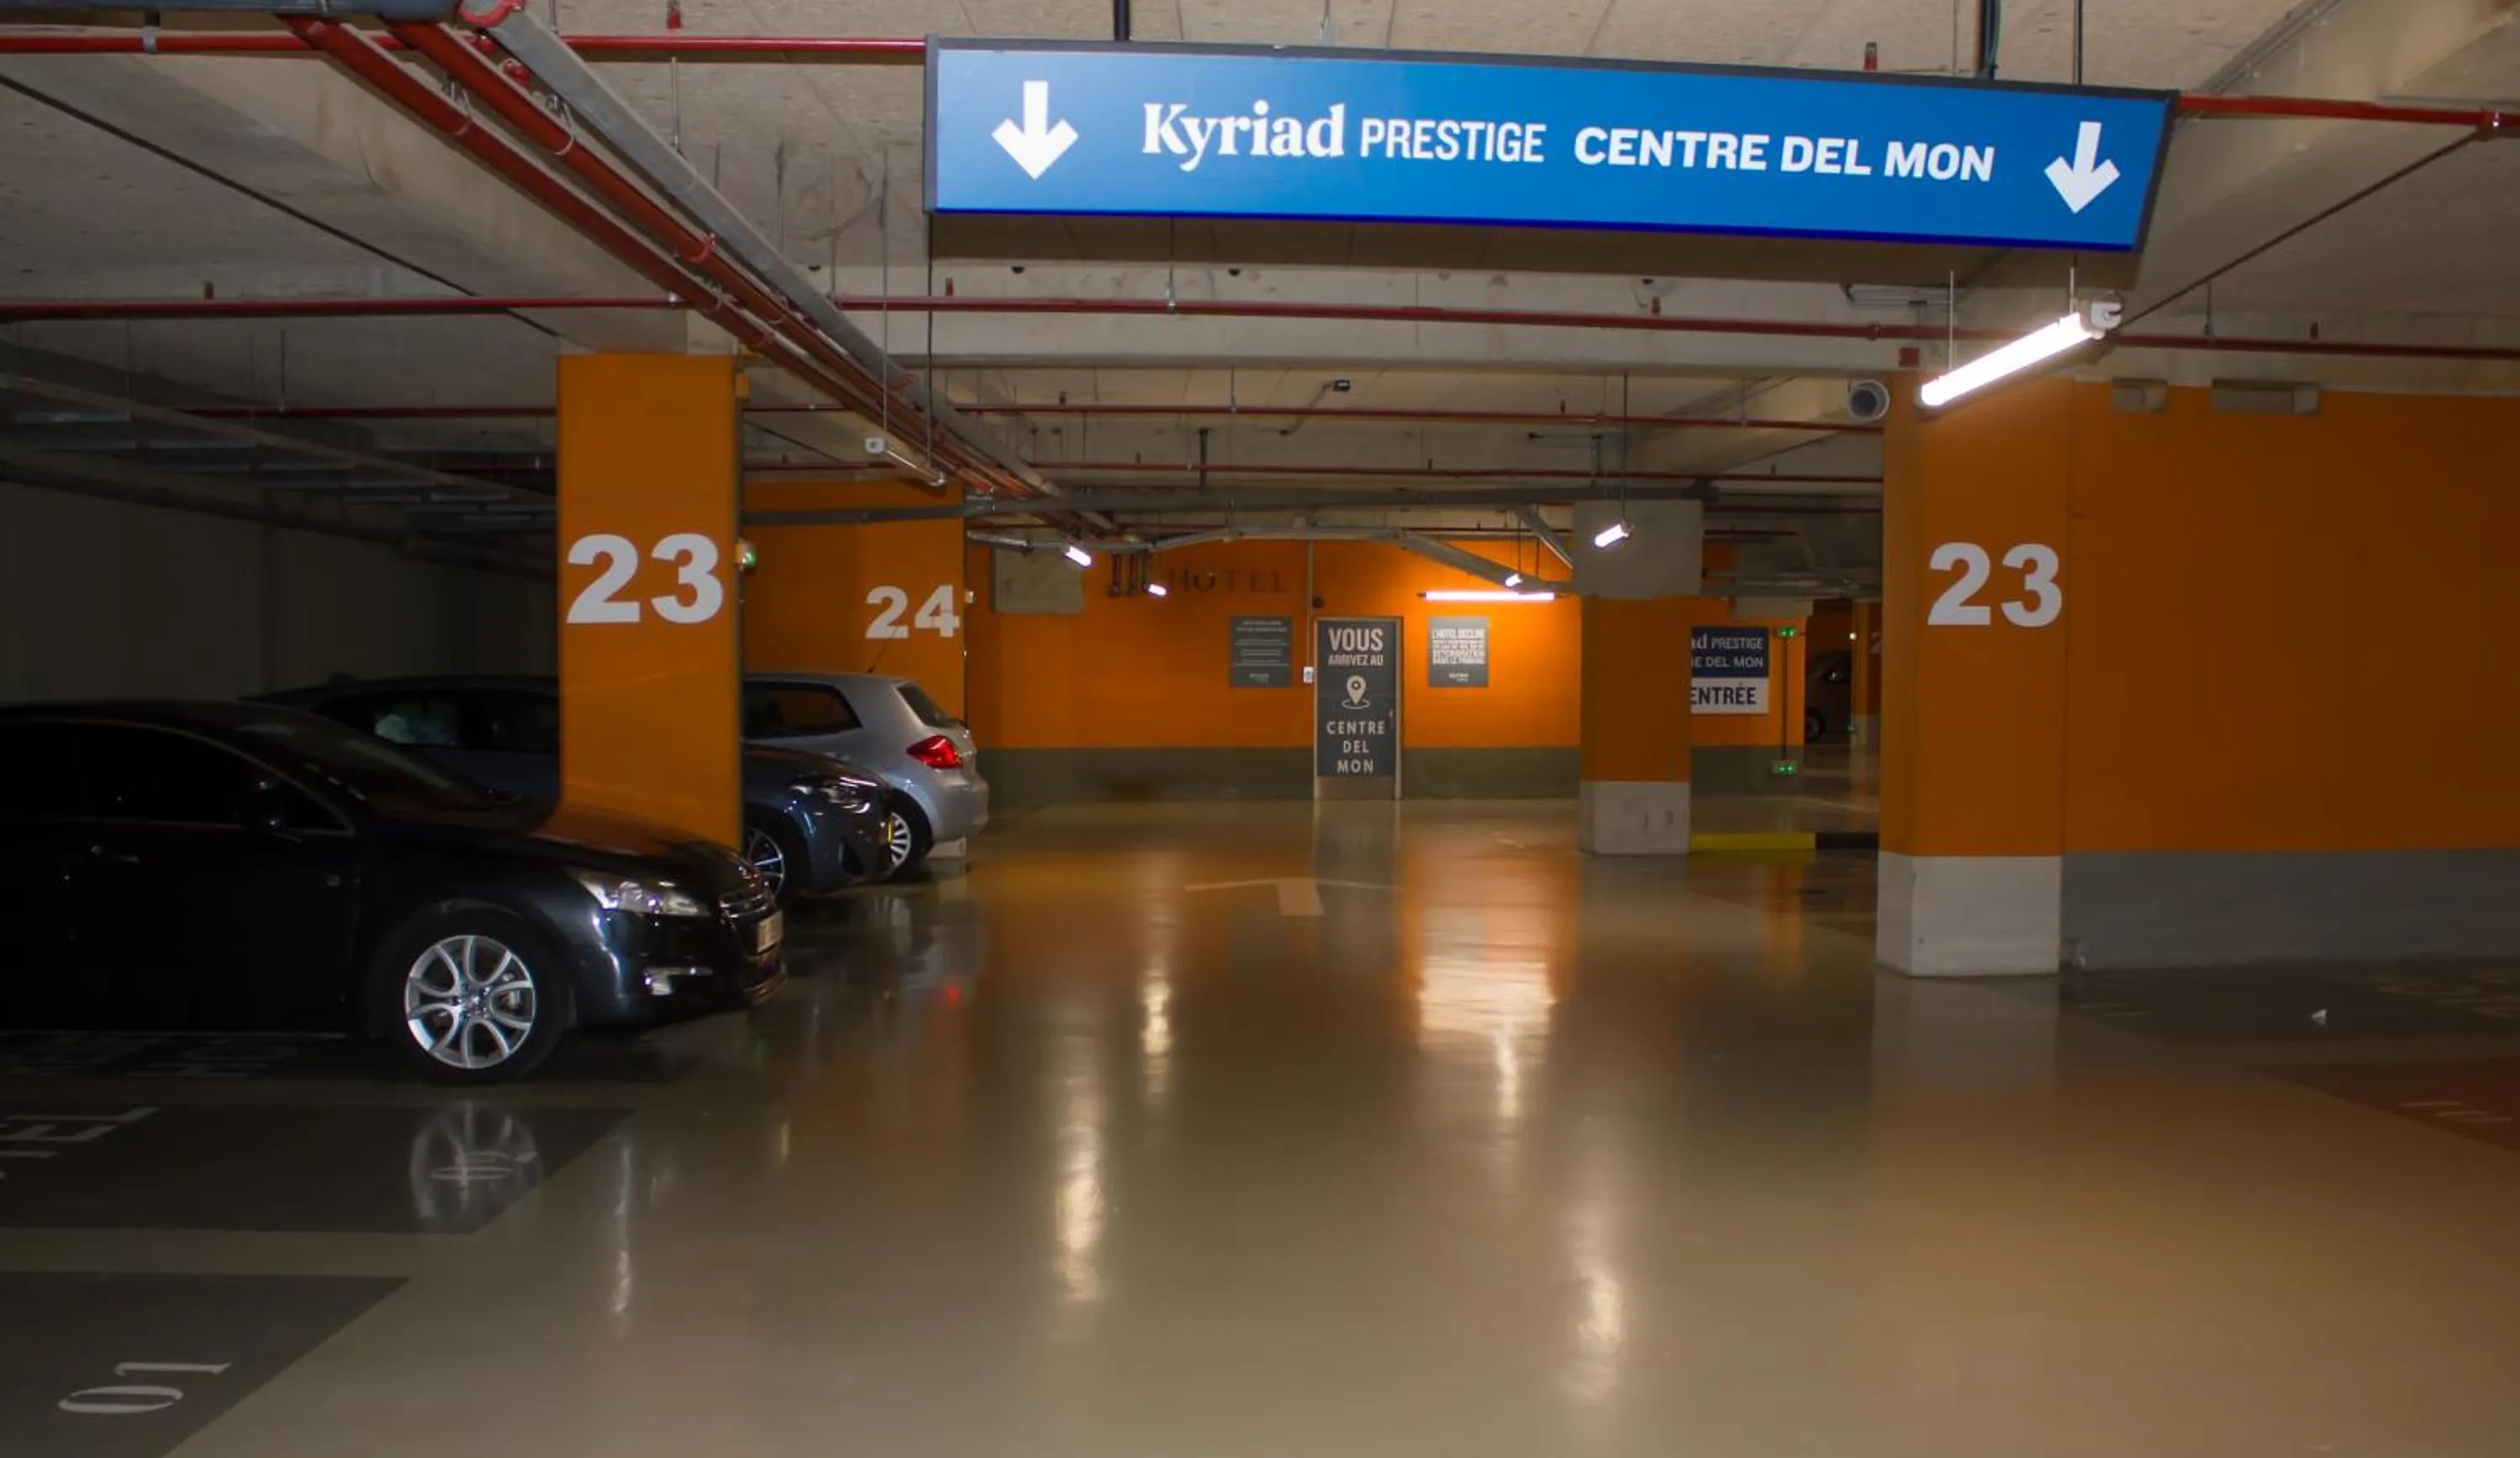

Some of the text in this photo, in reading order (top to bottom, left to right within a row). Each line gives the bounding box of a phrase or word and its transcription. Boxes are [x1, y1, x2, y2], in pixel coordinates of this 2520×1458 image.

[1142, 99, 1995, 182] Kyriad PRESTIGE CENTRE DEL MON
[566, 532, 723, 623] 23
[1927, 542, 2063, 627] 23
[865, 585, 960, 639] 24
[1328, 627, 1384, 652] VOUS
[1711, 637, 1764, 650] PRESTIGE
[1328, 654, 1384, 667] ARRIVEZ AU
[1705, 656, 1730, 668] DEL
[1733, 656, 1763, 668] MON
[1326, 721, 1385, 735] CENTRE
[1342, 740, 1370, 753] DEL
[1336, 758, 1374, 774] MON
